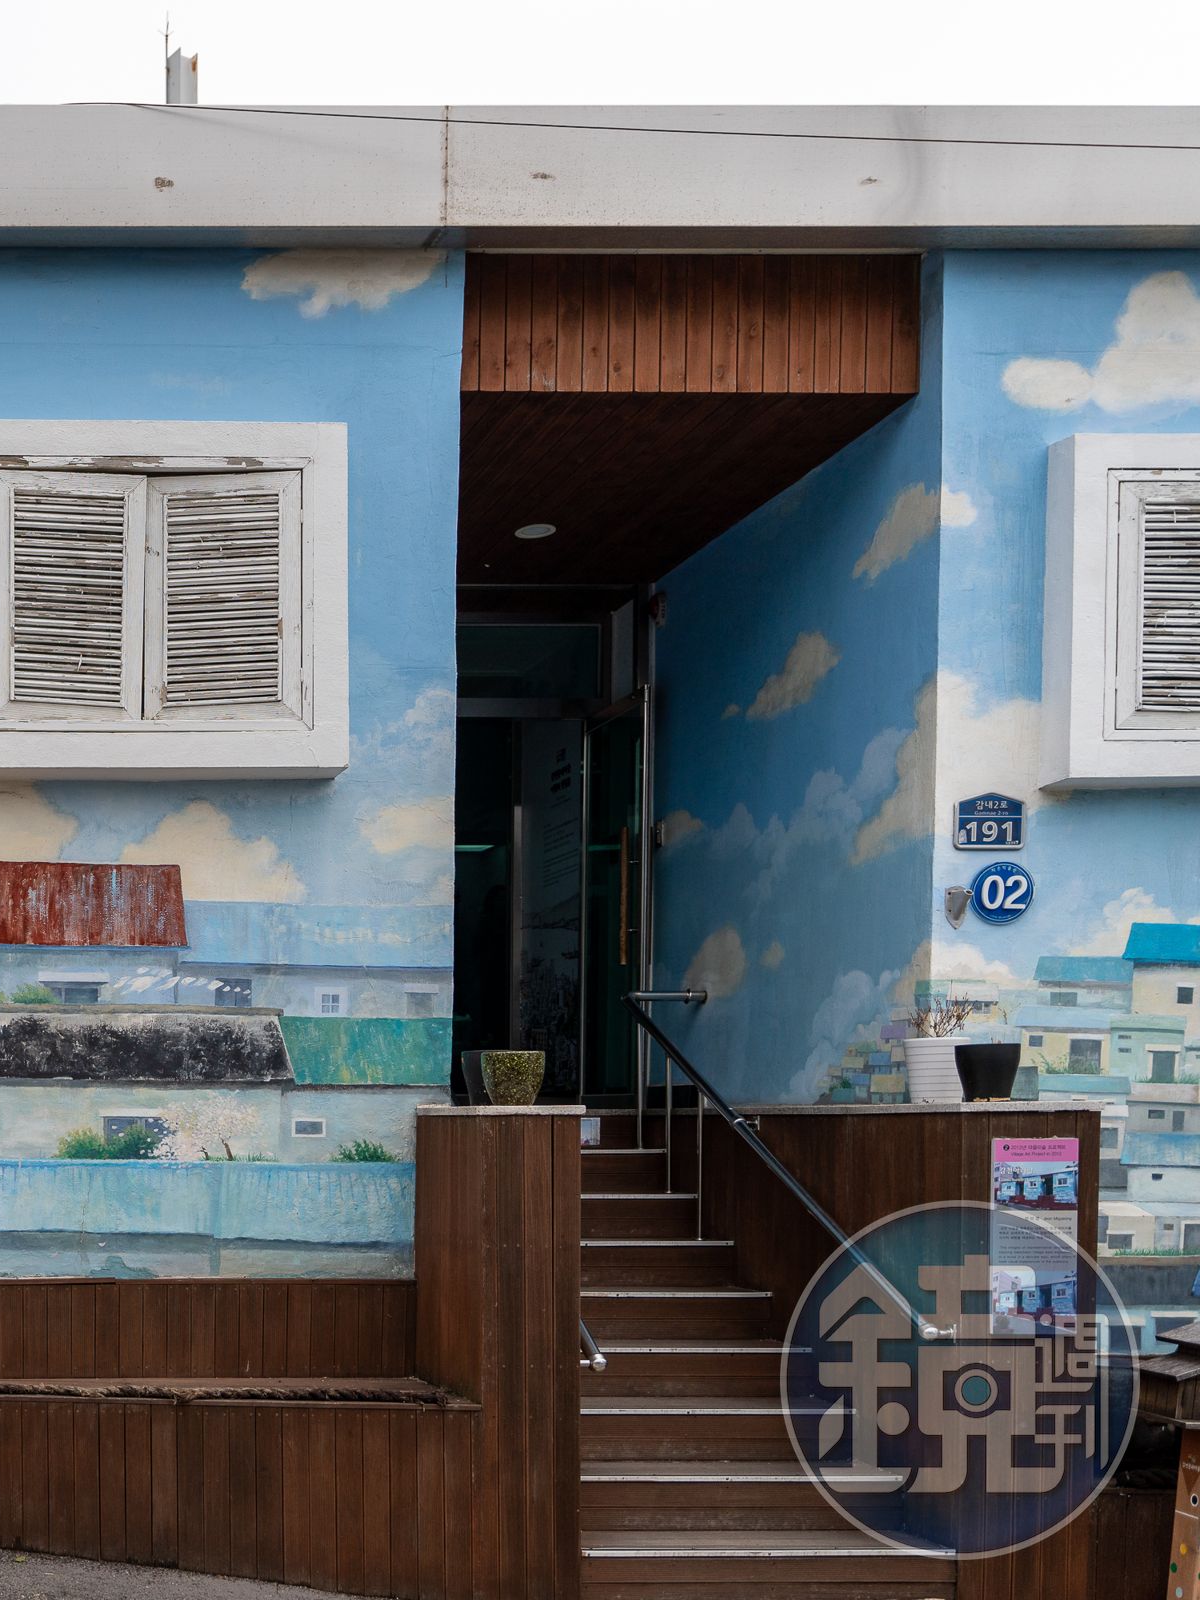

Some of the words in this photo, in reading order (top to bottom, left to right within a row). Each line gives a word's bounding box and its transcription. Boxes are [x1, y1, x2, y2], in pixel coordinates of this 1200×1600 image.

[975, 800, 1009, 810] 감내2로
[965, 820, 1013, 842] 191
[981, 874, 1029, 910] 02
